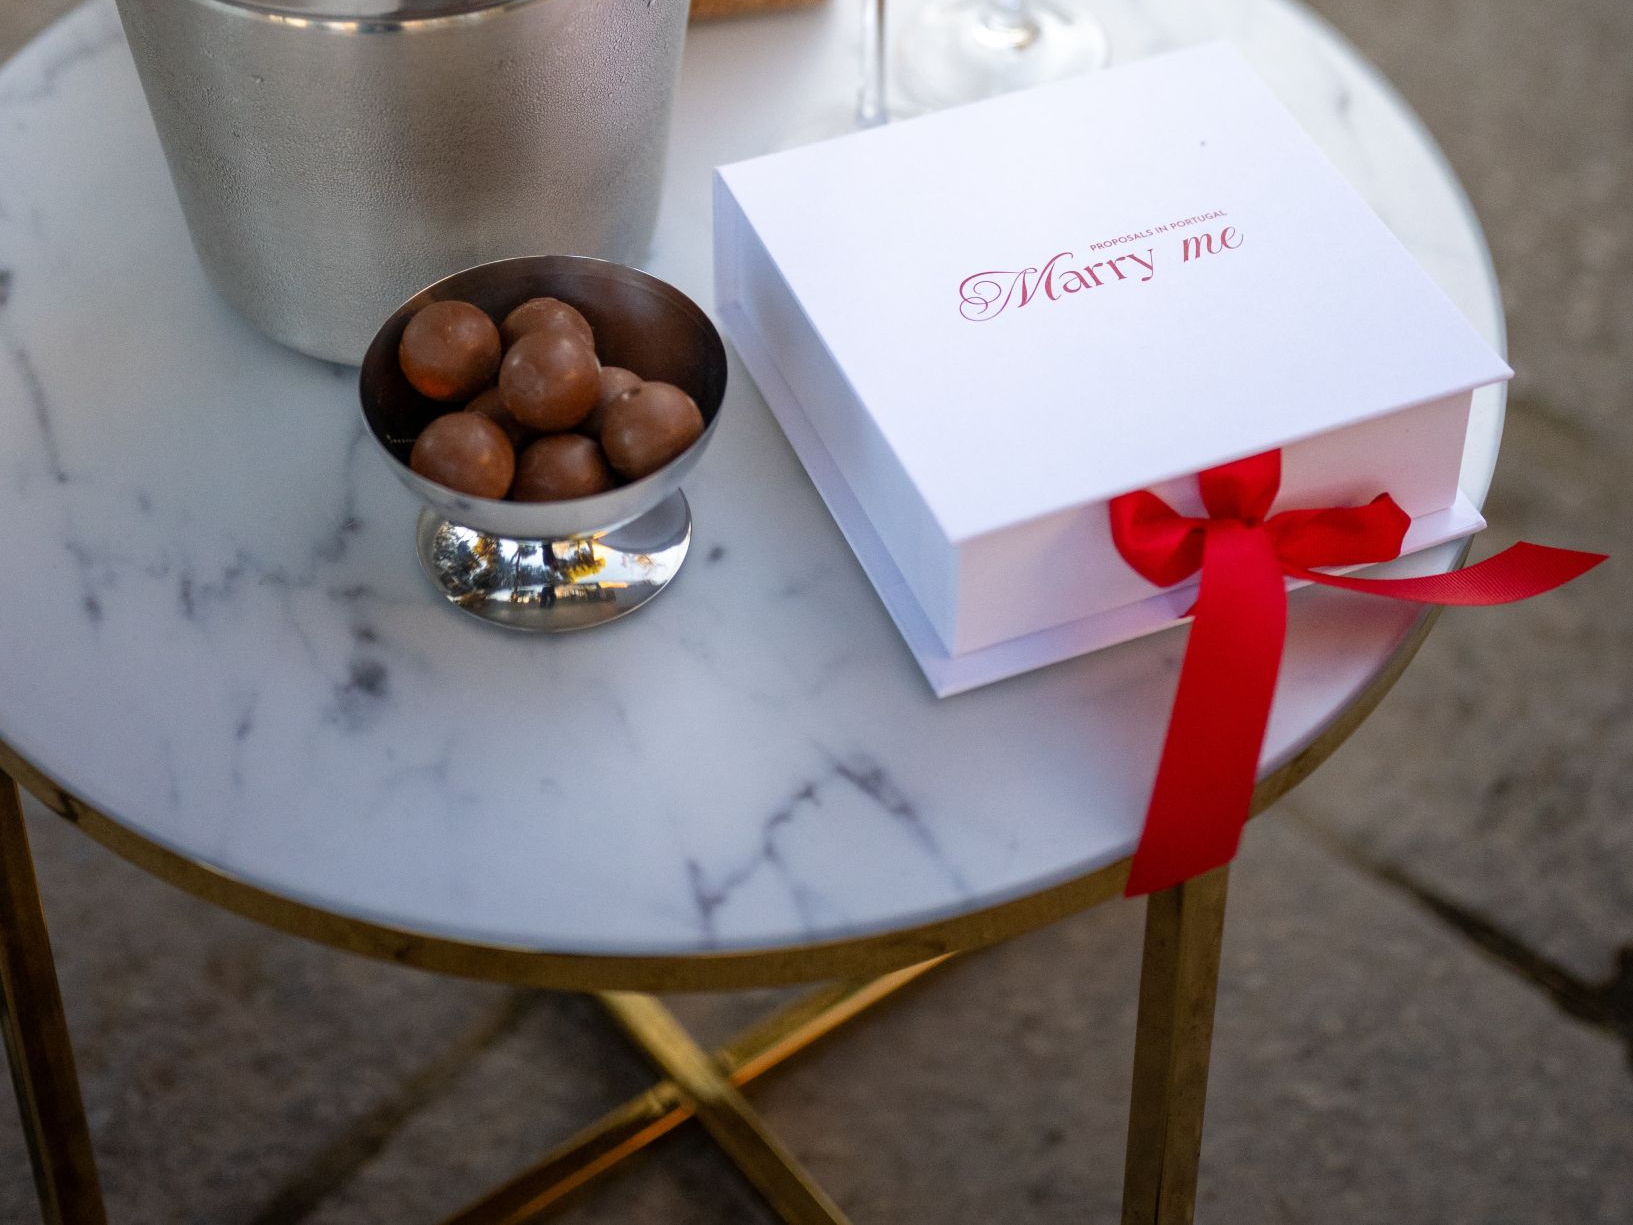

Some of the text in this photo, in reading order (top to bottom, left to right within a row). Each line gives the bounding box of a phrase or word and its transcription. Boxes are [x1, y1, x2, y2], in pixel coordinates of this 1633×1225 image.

[1089, 210, 1228, 252] PROPOSALS IN PORTUGAL
[959, 226, 1244, 322] Marry me
